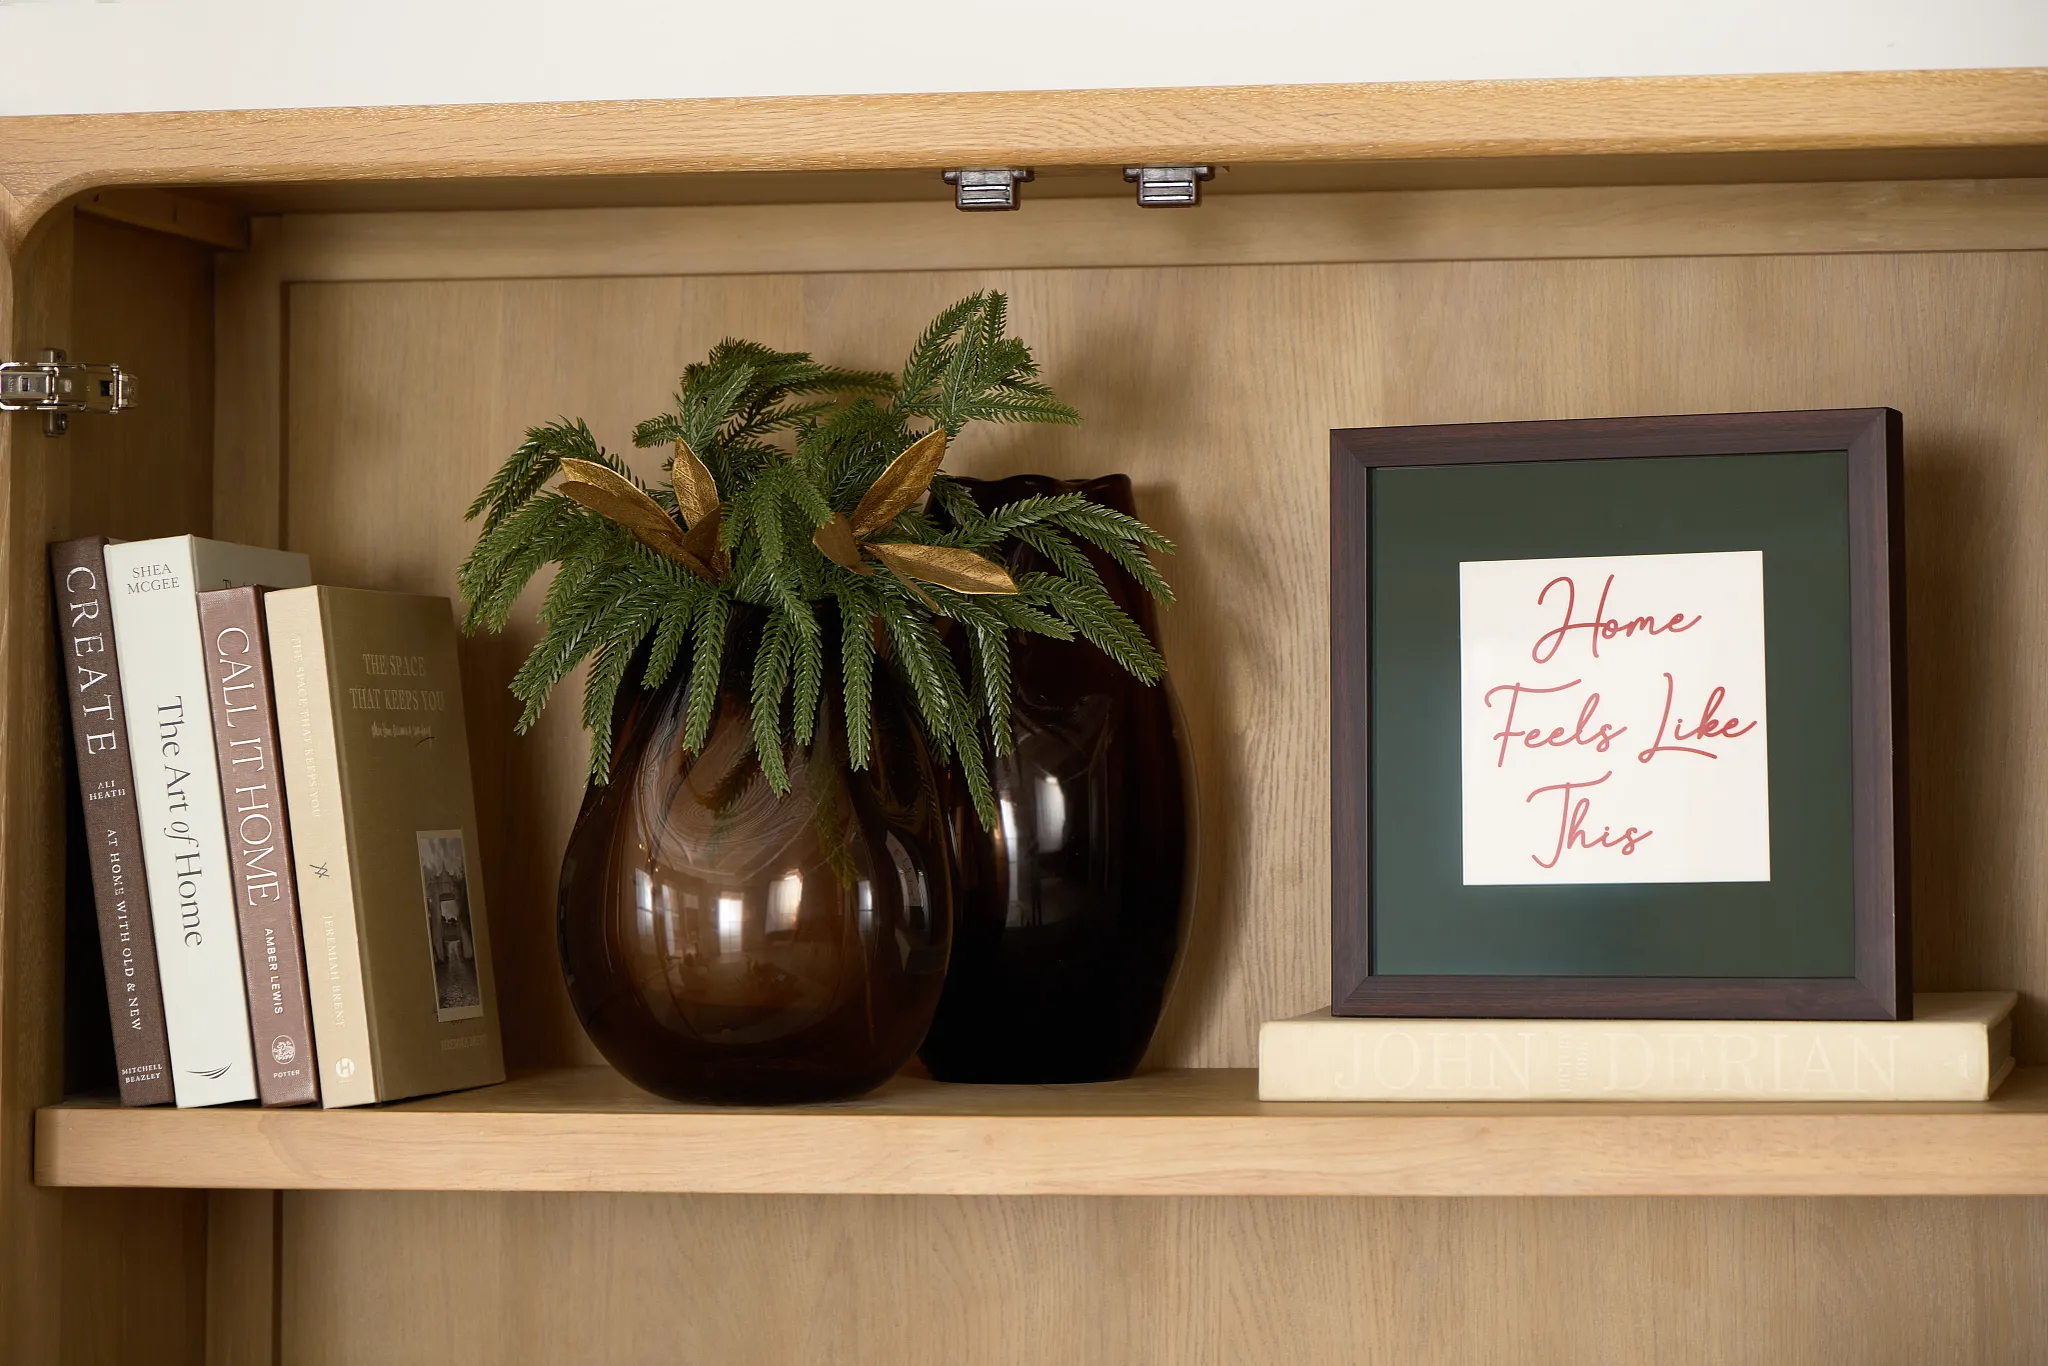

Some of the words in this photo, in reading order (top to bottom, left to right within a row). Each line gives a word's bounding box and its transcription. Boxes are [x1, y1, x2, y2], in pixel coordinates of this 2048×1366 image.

[126, 576, 180, 595] MCGEE
[132, 563, 172, 579] SHEA
[1532, 574, 1702, 664] Home
[66, 566, 117, 756] CREATE
[292, 636, 304, 663] THE
[362, 653, 387, 676] THE
[388, 654, 426, 677] SPACE
[216, 626, 257, 728] CALL
[295, 666, 309, 706] SPACE
[349, 687, 381, 710] THAT
[383, 689, 419, 711] KEEPS
[420, 690, 445, 712] YOU
[157, 695, 185, 758] The
[300, 708, 314, 744] THAT
[1484, 678, 1628, 767] Feels
[1638, 672, 1757, 764] Like
[229, 736, 265, 773] IT
[304, 748, 319, 788] KEEPS
[89, 788, 126, 801] HEATH
[97, 780, 116, 790] ALI
[164, 763, 192, 814] Art
[309, 790, 322, 819] YOU
[1526, 770, 1653, 869] This
[107, 828, 119, 847] AT
[163, 821, 199, 848] of
[235, 782, 281, 907] HOME
[109, 851, 125, 896] HOME
[174, 850, 204, 948] Home
[115, 900, 131, 943] WITH
[121, 947, 136, 977] OLD
[264, 928, 278, 972] AMBER
[321, 914, 341, 981] JEREMIAH
[126, 982, 137, 992] &
[270, 976, 283, 1015] LEWIS
[127, 996, 142, 1031] NEW
[121, 1063, 163, 1076] MITCHELL
[125, 1072, 161, 1084] BEAZLEY
[273, 1069, 300, 1079] POTTER
[1333, 1031, 1538, 1092] JOHN
[1602, 1032, 1901, 1092] DERIAN
